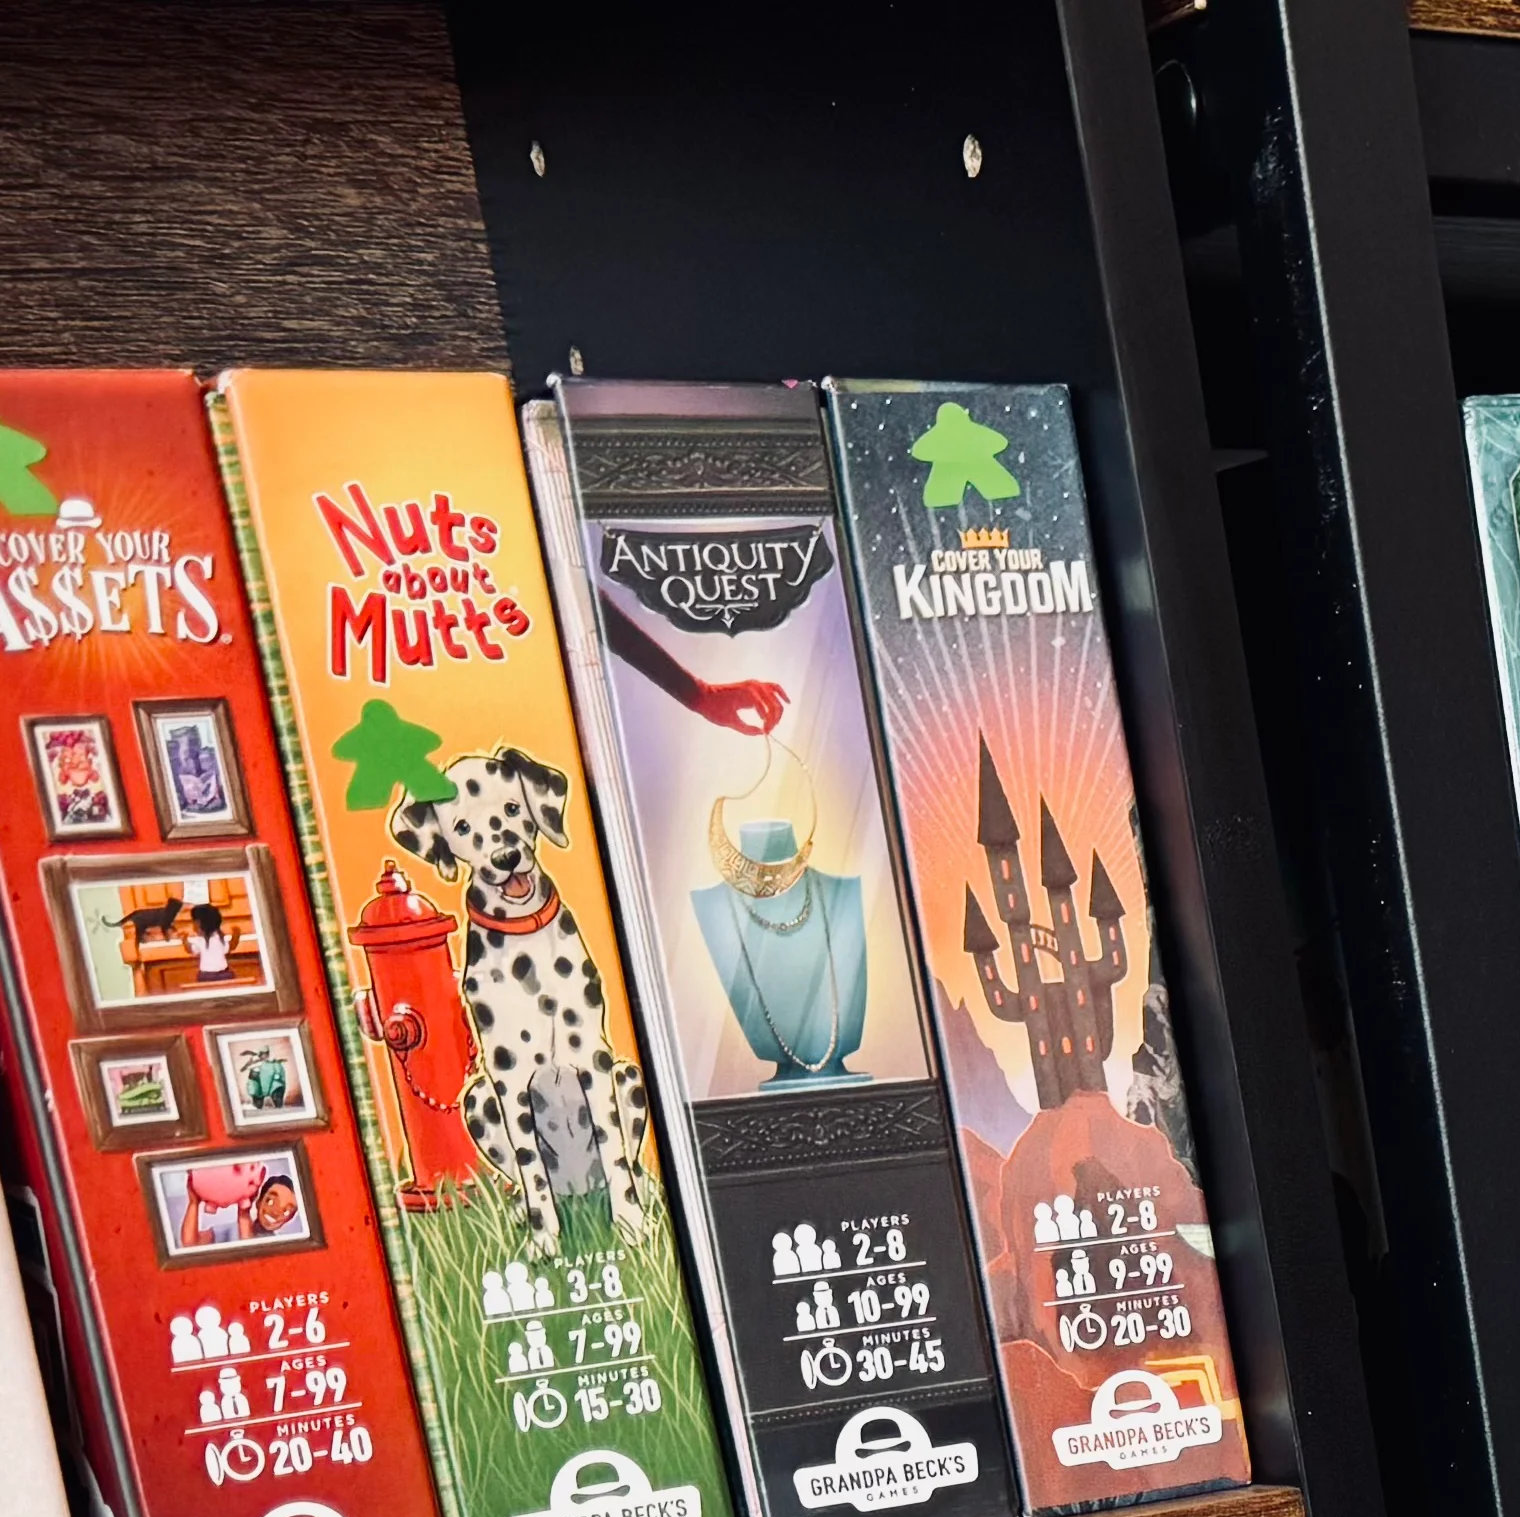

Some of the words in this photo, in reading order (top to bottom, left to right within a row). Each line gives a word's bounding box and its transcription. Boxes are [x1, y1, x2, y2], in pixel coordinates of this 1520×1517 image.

[98, 532, 171, 563] YOUR
[314, 484, 498, 577] Nuts
[382, 562, 496, 597] about
[609, 533, 819, 599] ANTIQUITY
[932, 551, 990, 571] COVER
[996, 548, 1042, 570] YOUR
[661, 571, 781, 615] QUEST
[893, 560, 1092, 619] KINGDOM
[330, 582, 530, 682] Mutts
[1108, 1199, 1158, 1234] 2-8
[554, 1249, 626, 1269] PLAYERS
[852, 1229, 906, 1266] 2-8
[567, 1264, 623, 1303] 3-8
[1109, 1251, 1174, 1292] 9-99
[249, 1291, 330, 1314] PLAYERS
[848, 1282, 930, 1325] 10-99
[264, 1308, 325, 1349] 2-6
[569, 1320, 641, 1364] 7-99
[1111, 1307, 1191, 1348] 20-30
[280, 1355, 327, 1373] AGES
[856, 1338, 946, 1382] 30-45
[265, 1367, 347, 1413] 7-99
[574, 1379, 662, 1423] 15-30
[277, 1413, 355, 1436] MINUTES
[1068, 1428, 1149, 1456] GRANDPA
[1153, 1416, 1211, 1441] BECK'S
[270, 1427, 373, 1477] 20-40
[810, 1467, 898, 1497] GRANDPA
[903, 1455, 966, 1481] BECK'S
